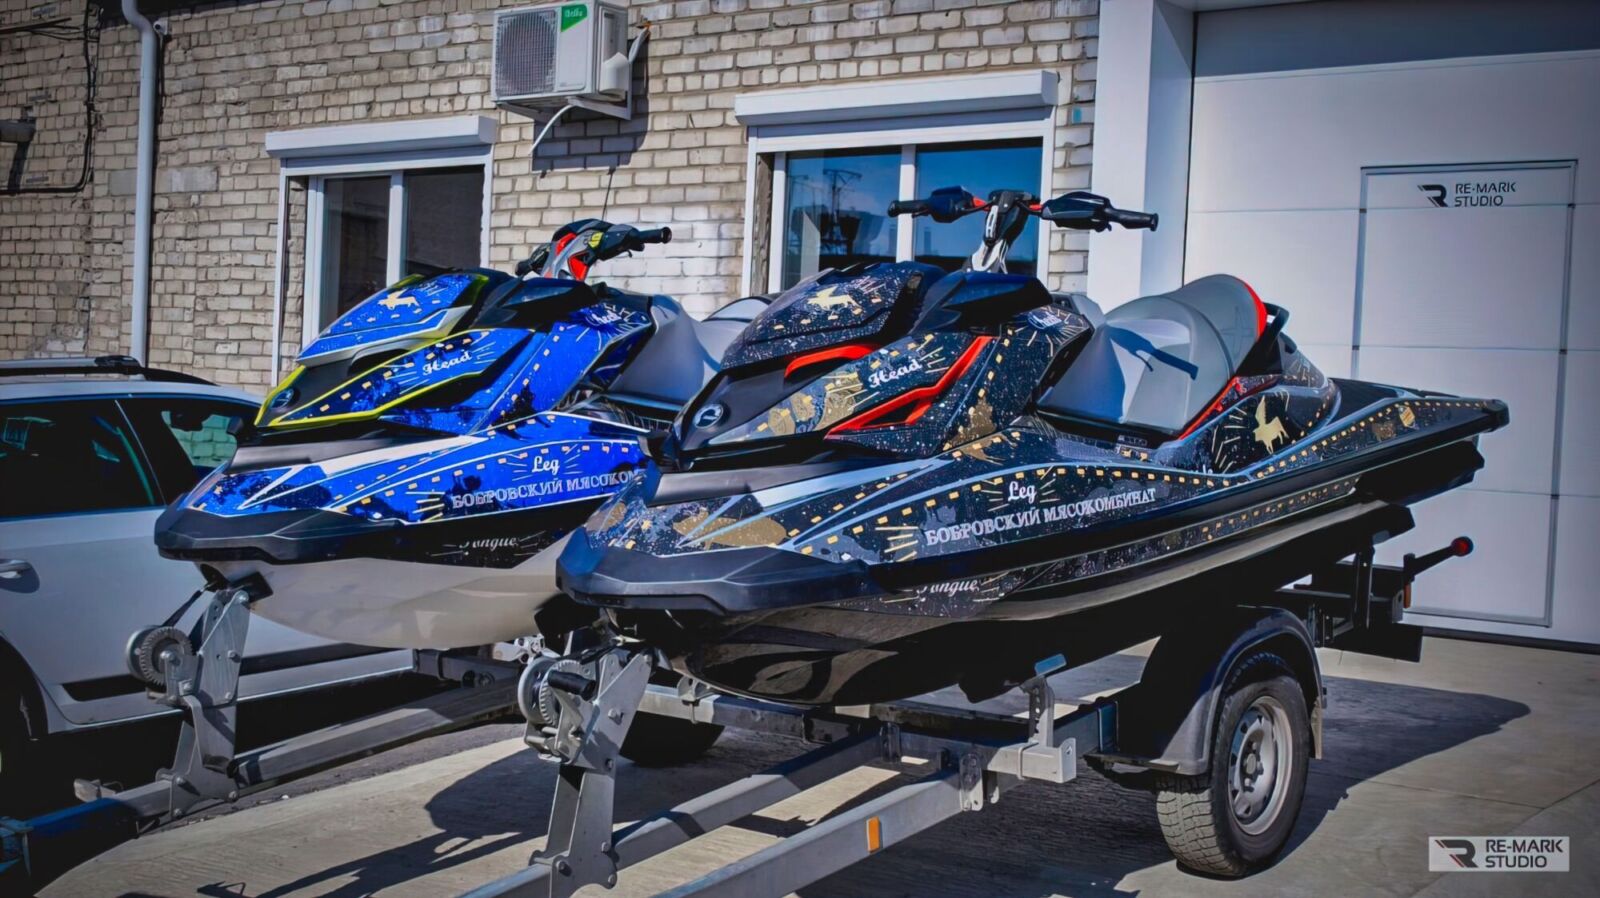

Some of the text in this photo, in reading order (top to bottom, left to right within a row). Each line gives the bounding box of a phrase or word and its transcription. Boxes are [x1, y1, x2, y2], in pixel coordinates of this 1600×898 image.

[1454, 195, 1503, 207] STUDIO
[422, 351, 473, 375] Head
[867, 358, 923, 388] Head
[531, 456, 560, 475] Leg
[452, 477, 563, 509] БОБРОВСКИЙ
[1008, 481, 1037, 504] Leg
[924, 488, 1156, 546] БОБРОВСКИЙ МЯСОКОМБИНАТ
